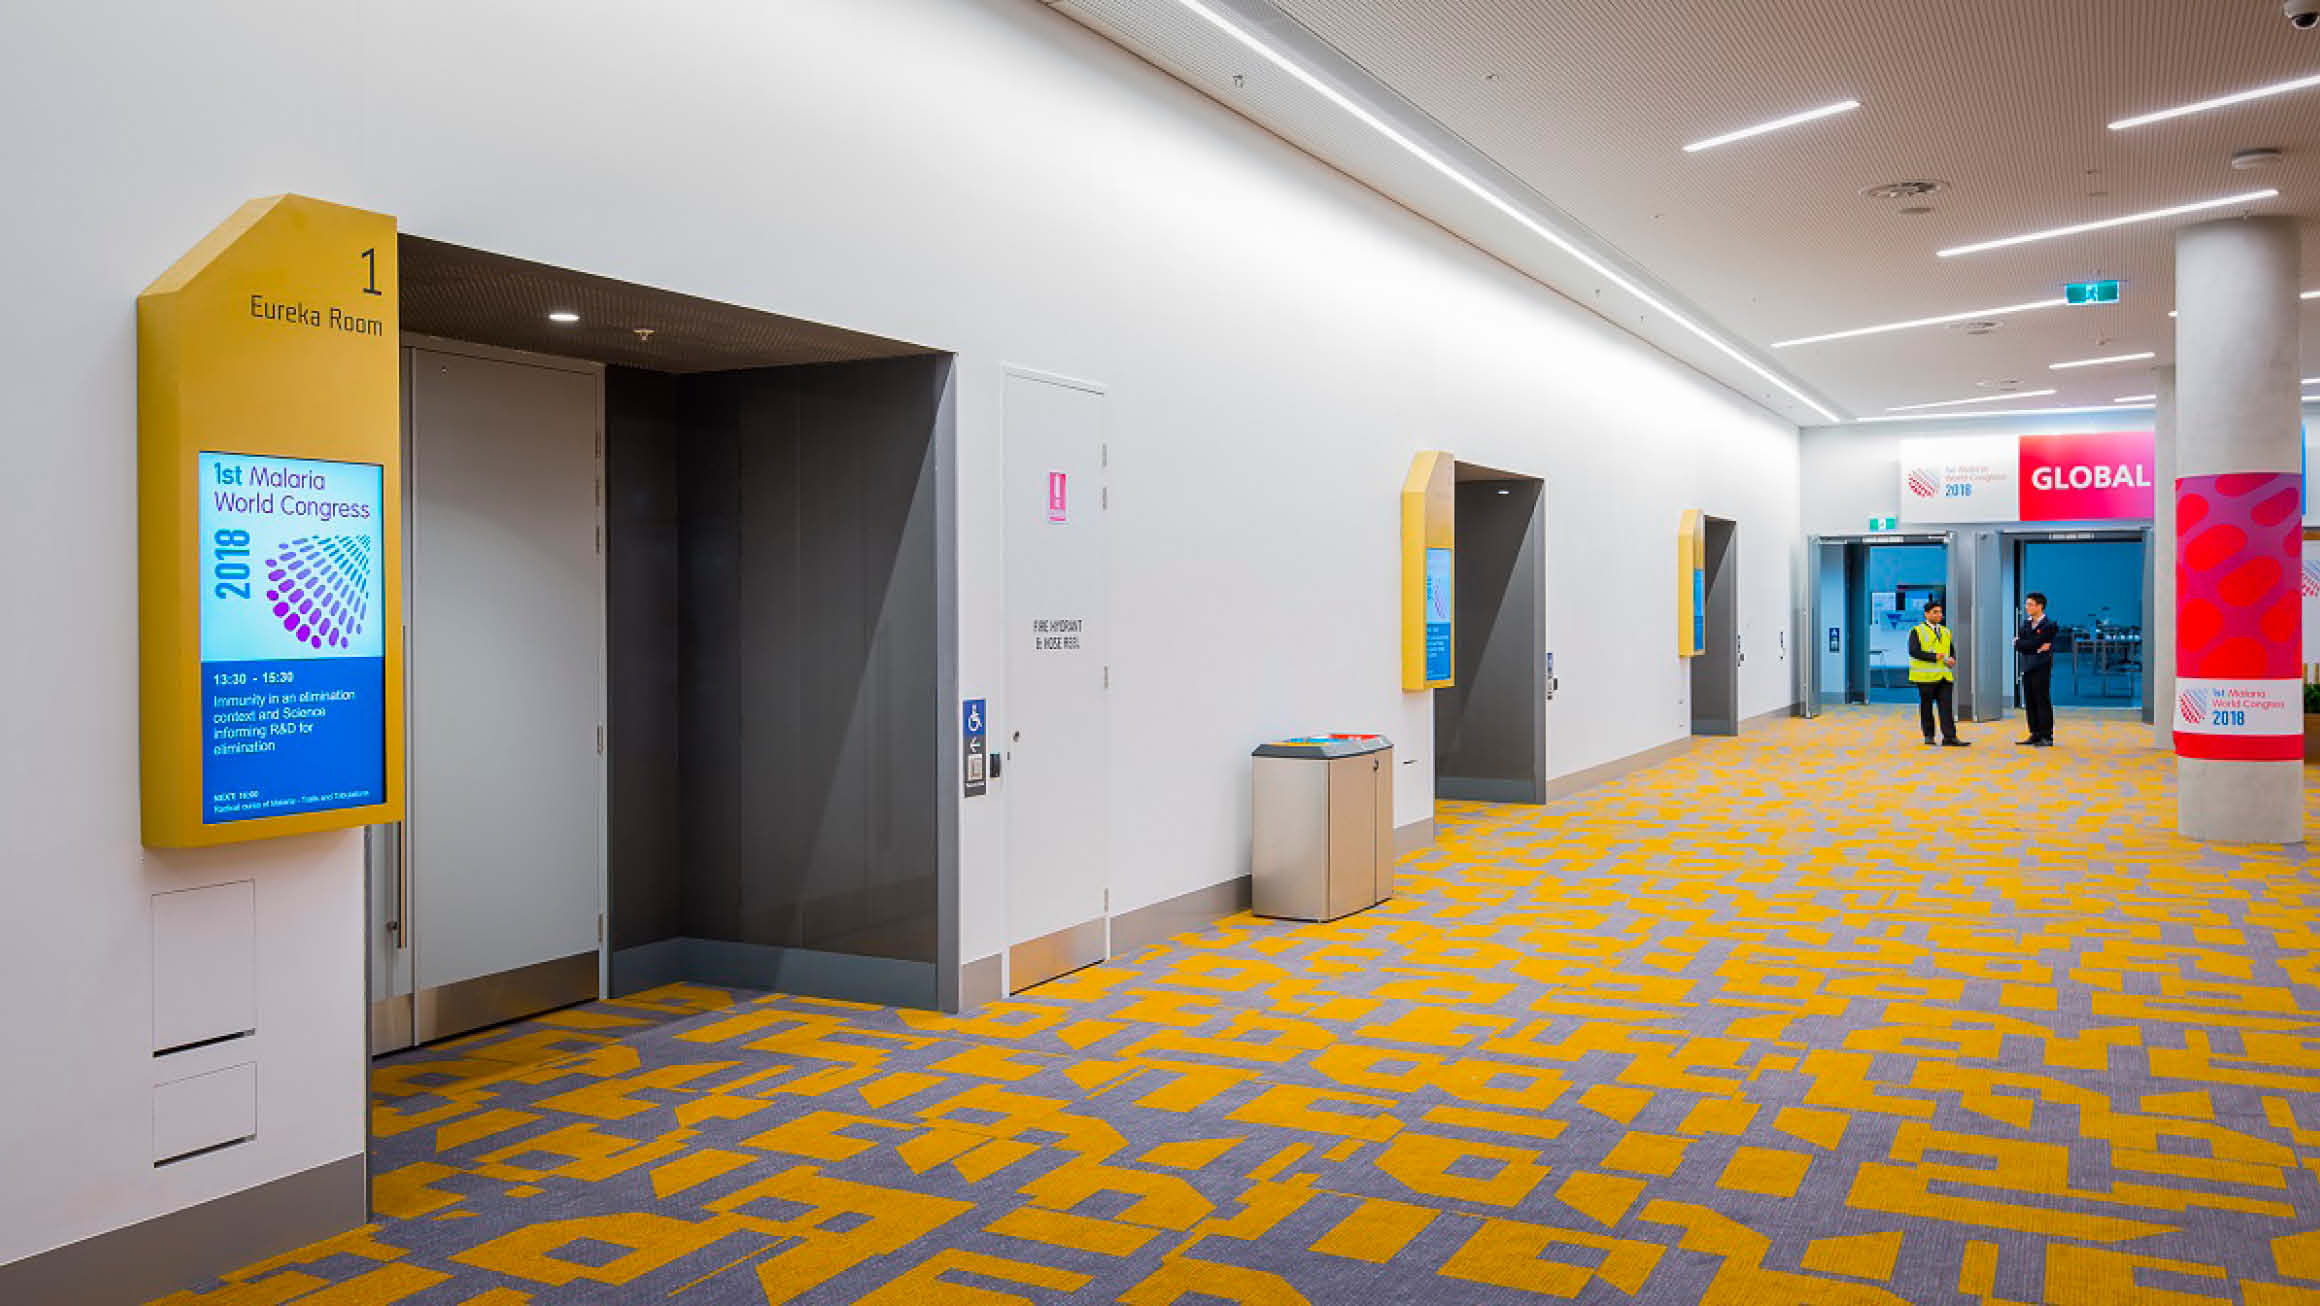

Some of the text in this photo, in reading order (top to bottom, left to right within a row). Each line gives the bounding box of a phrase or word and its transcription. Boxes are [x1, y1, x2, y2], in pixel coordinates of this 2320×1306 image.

[361, 247, 382, 296] 1
[250, 295, 382, 336] Eureka Room
[214, 462, 326, 490] 1st Malaria
[2031, 464, 2152, 490] GLOBAL
[1945, 483, 1972, 497] 2018
[214, 491, 370, 522] World Congress
[214, 528, 251, 600] 2018
[213, 673, 246, 685] 13:30
[262, 671, 294, 683] 15:30
[213, 689, 355, 708] Immunity in an elimination
[2227, 688, 2266, 698] Malaria
[2212, 699, 2240, 708] World
[213, 706, 326, 723] context and Science
[2212, 710, 2245, 726] 2018
[270, 722, 296, 735] R&D
[299, 721, 314, 734] for
[213, 740, 276, 756] elimination
